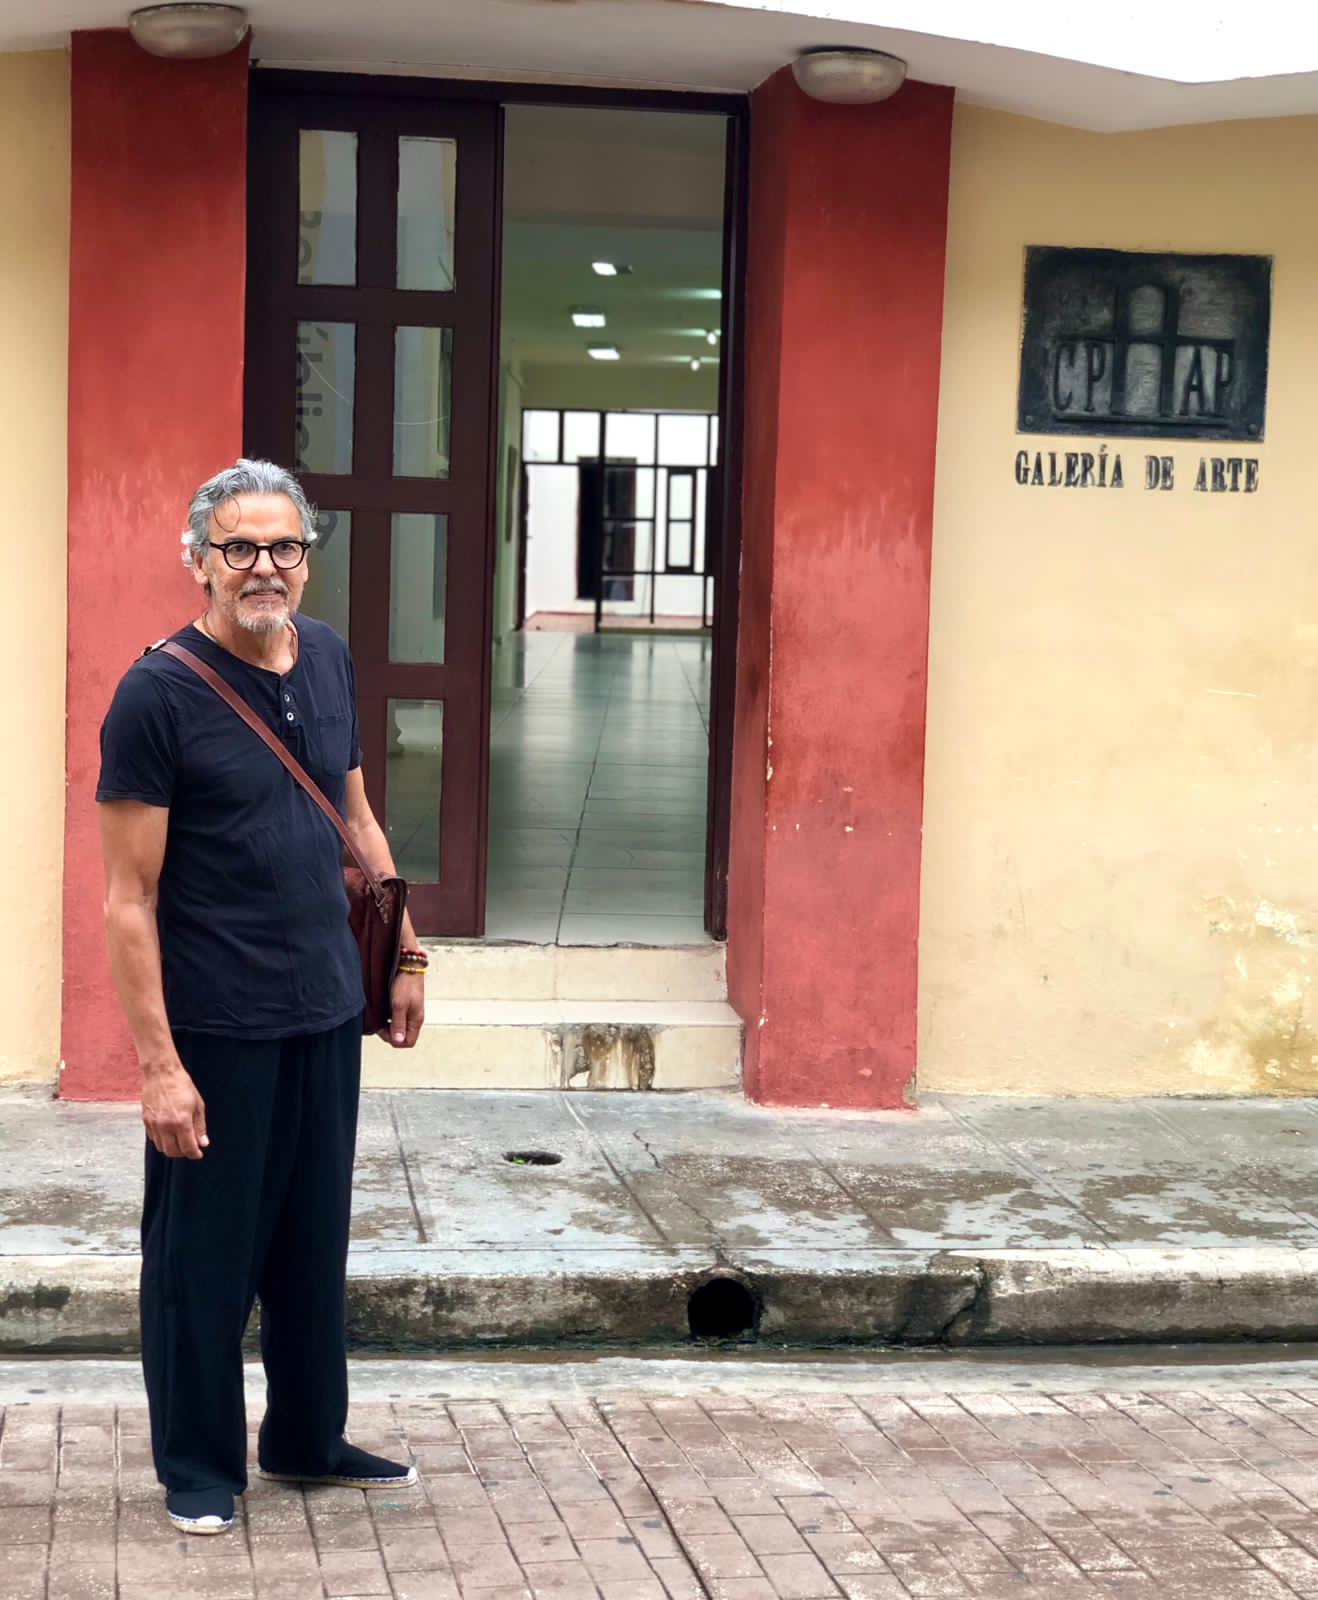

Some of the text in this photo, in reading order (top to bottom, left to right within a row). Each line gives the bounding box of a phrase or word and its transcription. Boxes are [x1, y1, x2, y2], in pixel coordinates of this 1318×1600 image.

[1015, 444, 1259, 493] GALERÍA DE ARTE
